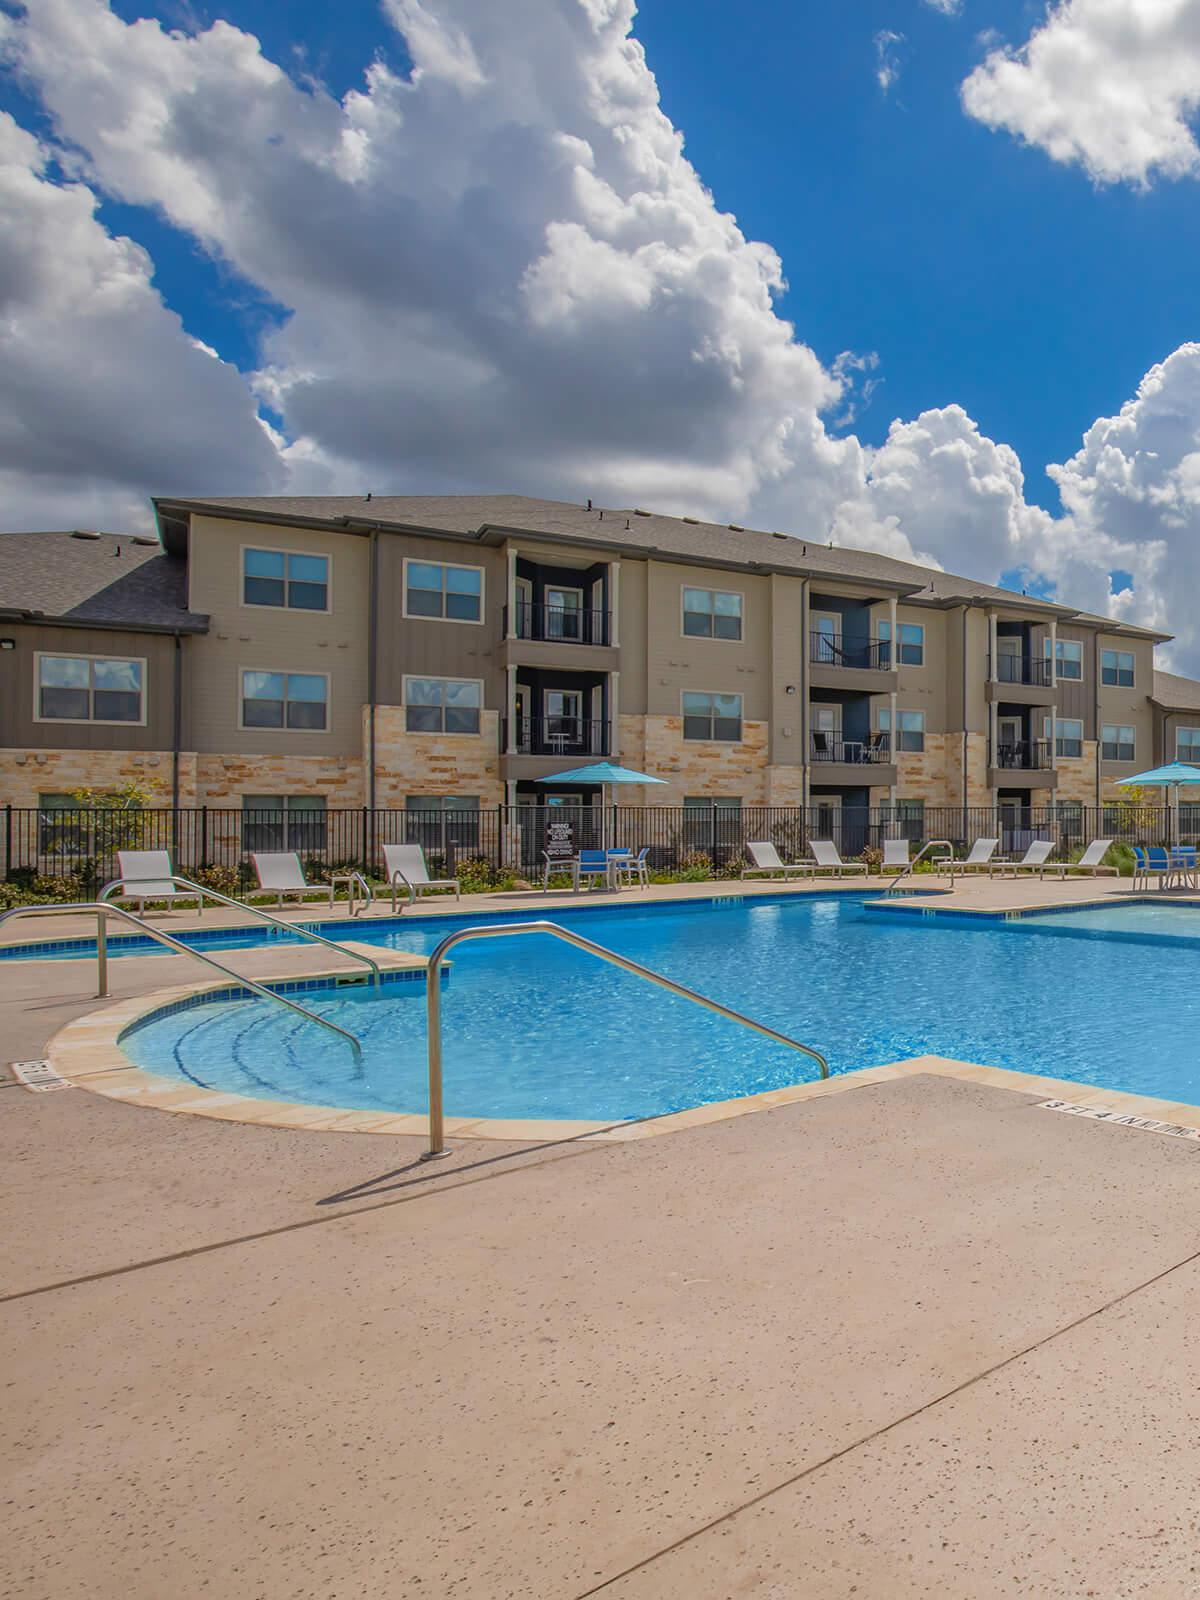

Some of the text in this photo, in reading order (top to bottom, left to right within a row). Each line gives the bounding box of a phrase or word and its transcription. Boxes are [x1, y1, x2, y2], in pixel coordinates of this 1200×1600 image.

[1045, 1101, 1065, 1109] 3
[1064, 1105, 1095, 1114] FT
[1113, 1115, 1143, 1125] IN
